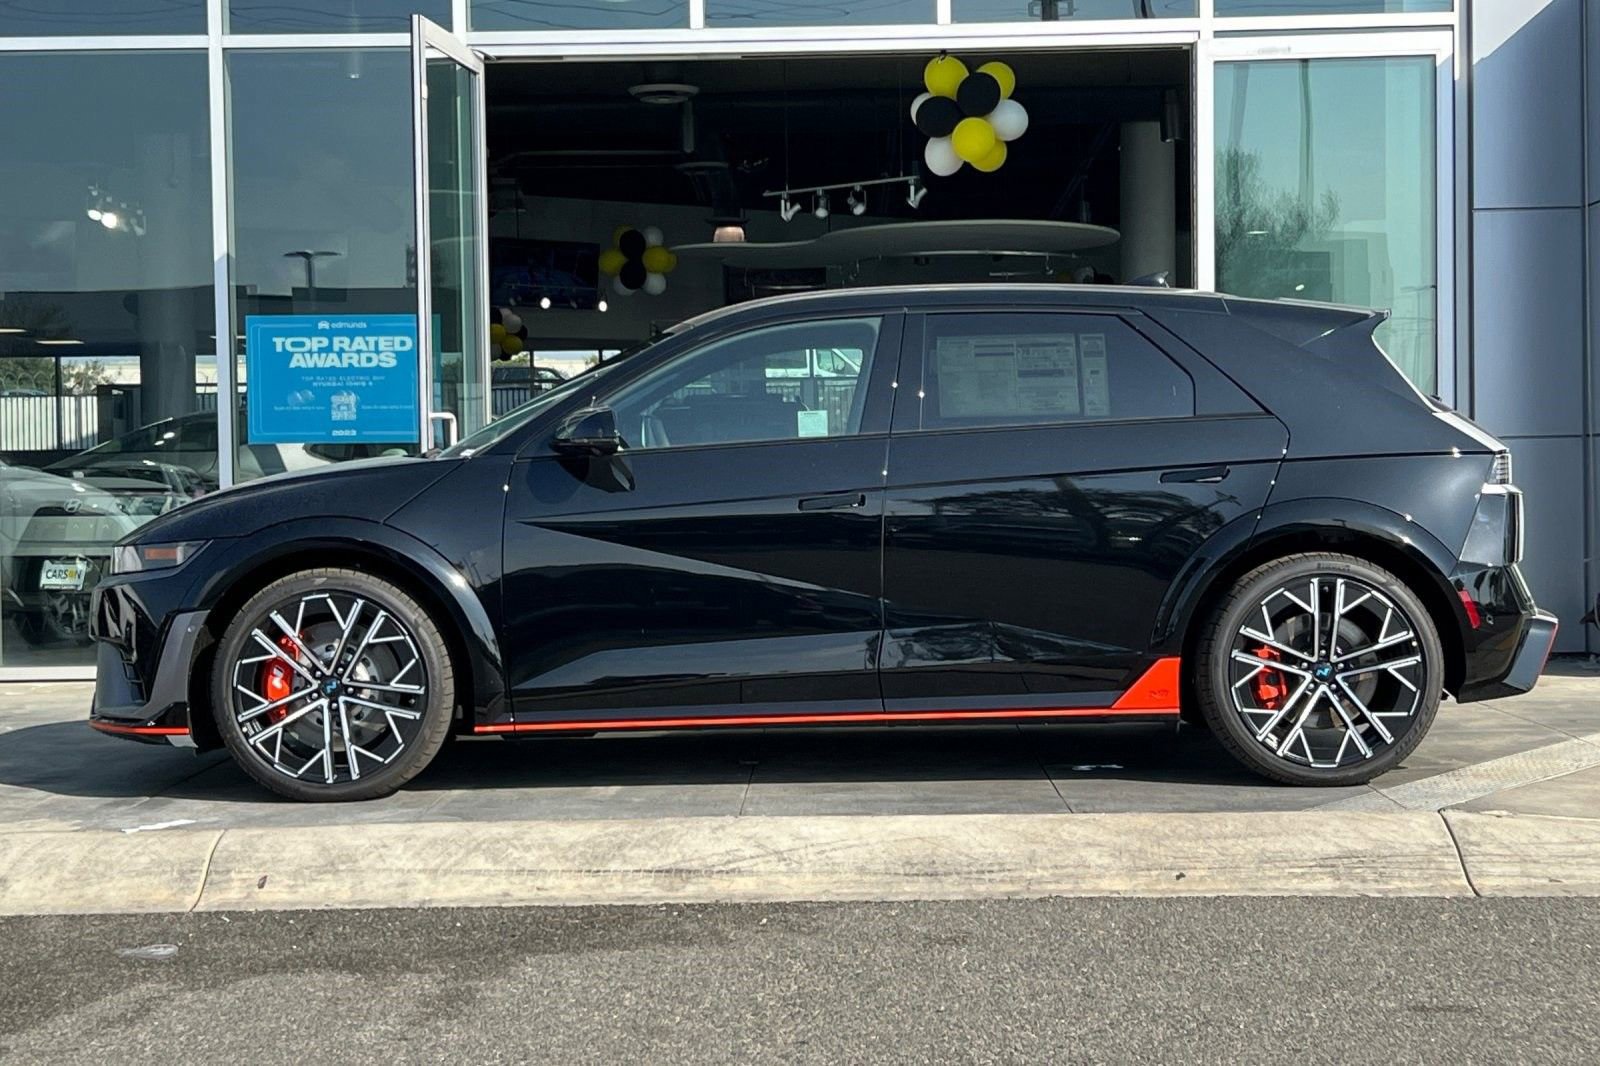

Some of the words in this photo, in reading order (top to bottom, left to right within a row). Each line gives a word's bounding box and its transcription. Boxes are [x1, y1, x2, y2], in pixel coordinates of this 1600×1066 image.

[330, 320, 367, 329] edmunds
[273, 336, 329, 352] TOP
[333, 336, 412, 352] RATED
[289, 352, 397, 368] AWARDS
[46, 568, 82, 579] CARSON
